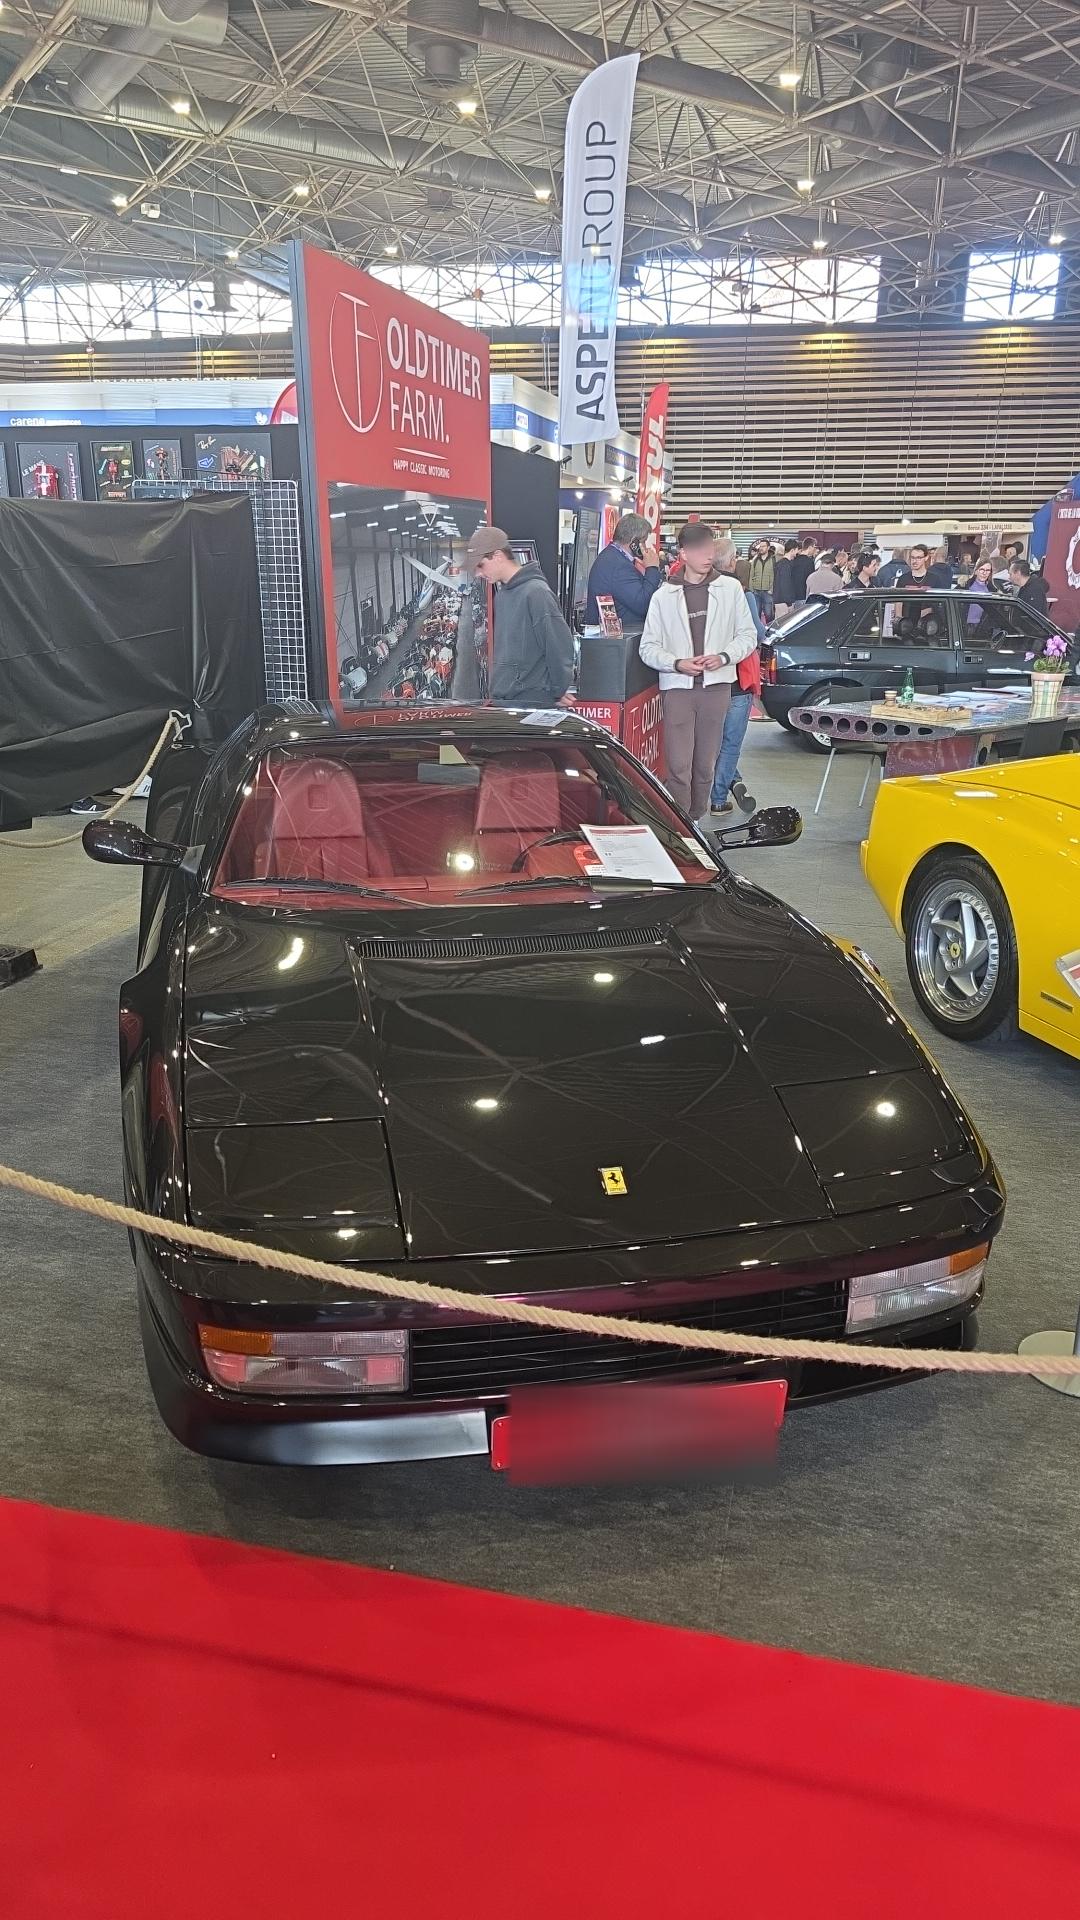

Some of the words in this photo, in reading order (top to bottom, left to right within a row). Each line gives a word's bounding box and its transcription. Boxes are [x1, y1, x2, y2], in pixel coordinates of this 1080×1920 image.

[575, 121, 617, 422] ASPENGROUP
[387, 317, 482, 401] OLDTIMER
[389, 382, 450, 444] FARM.
[393, 459, 409, 471] HAPPY
[410, 461, 427, 475] CLASSIC
[428, 465, 450, 479] MOTORING
